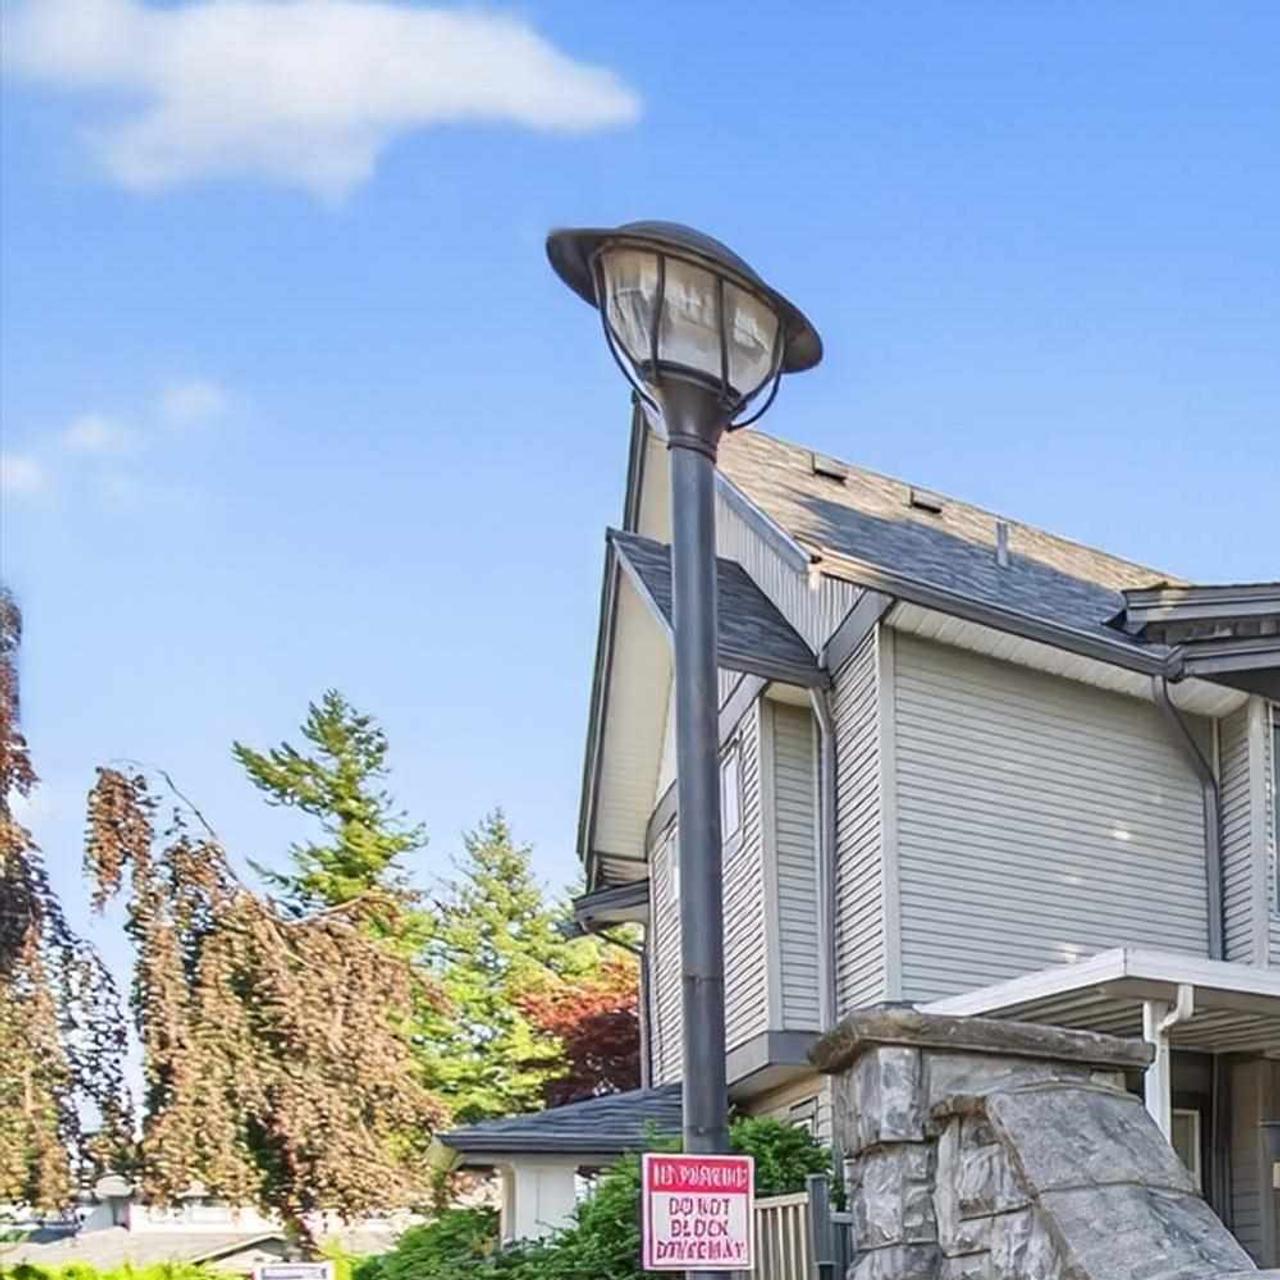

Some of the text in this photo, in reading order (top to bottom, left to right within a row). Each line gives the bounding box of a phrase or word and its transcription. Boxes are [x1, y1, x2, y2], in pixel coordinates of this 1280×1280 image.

[669, 1198, 730, 1216] DO NOT
[671, 1219, 729, 1238] BLOCK
